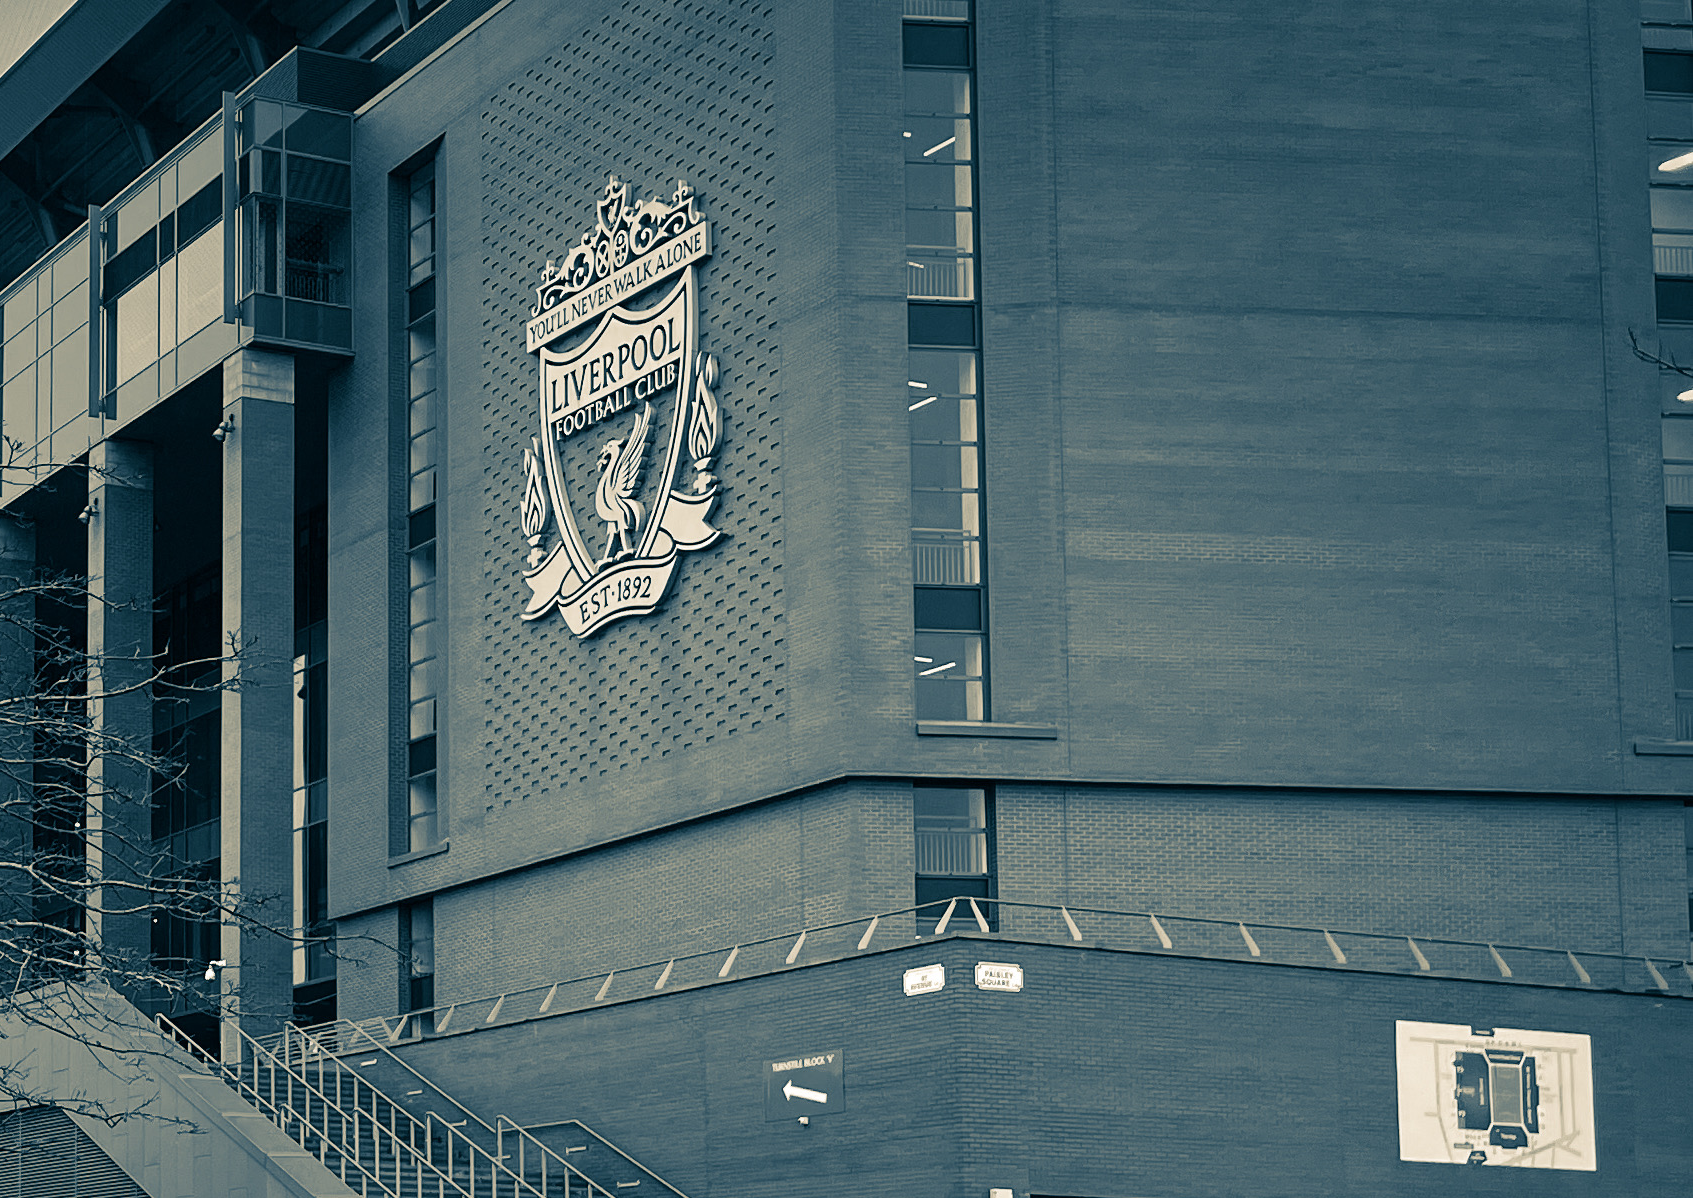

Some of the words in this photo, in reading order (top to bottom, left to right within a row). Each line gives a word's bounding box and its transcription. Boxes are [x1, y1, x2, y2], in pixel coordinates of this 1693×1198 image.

[571, 282, 614, 322] NEVER
[613, 259, 653, 296] WALK
[653, 230, 702, 275] ALONE
[551, 317, 681, 414] LIVERPOOL
[555, 386, 632, 441] FOOTBALL
[634, 363, 676, 400] CLUB
